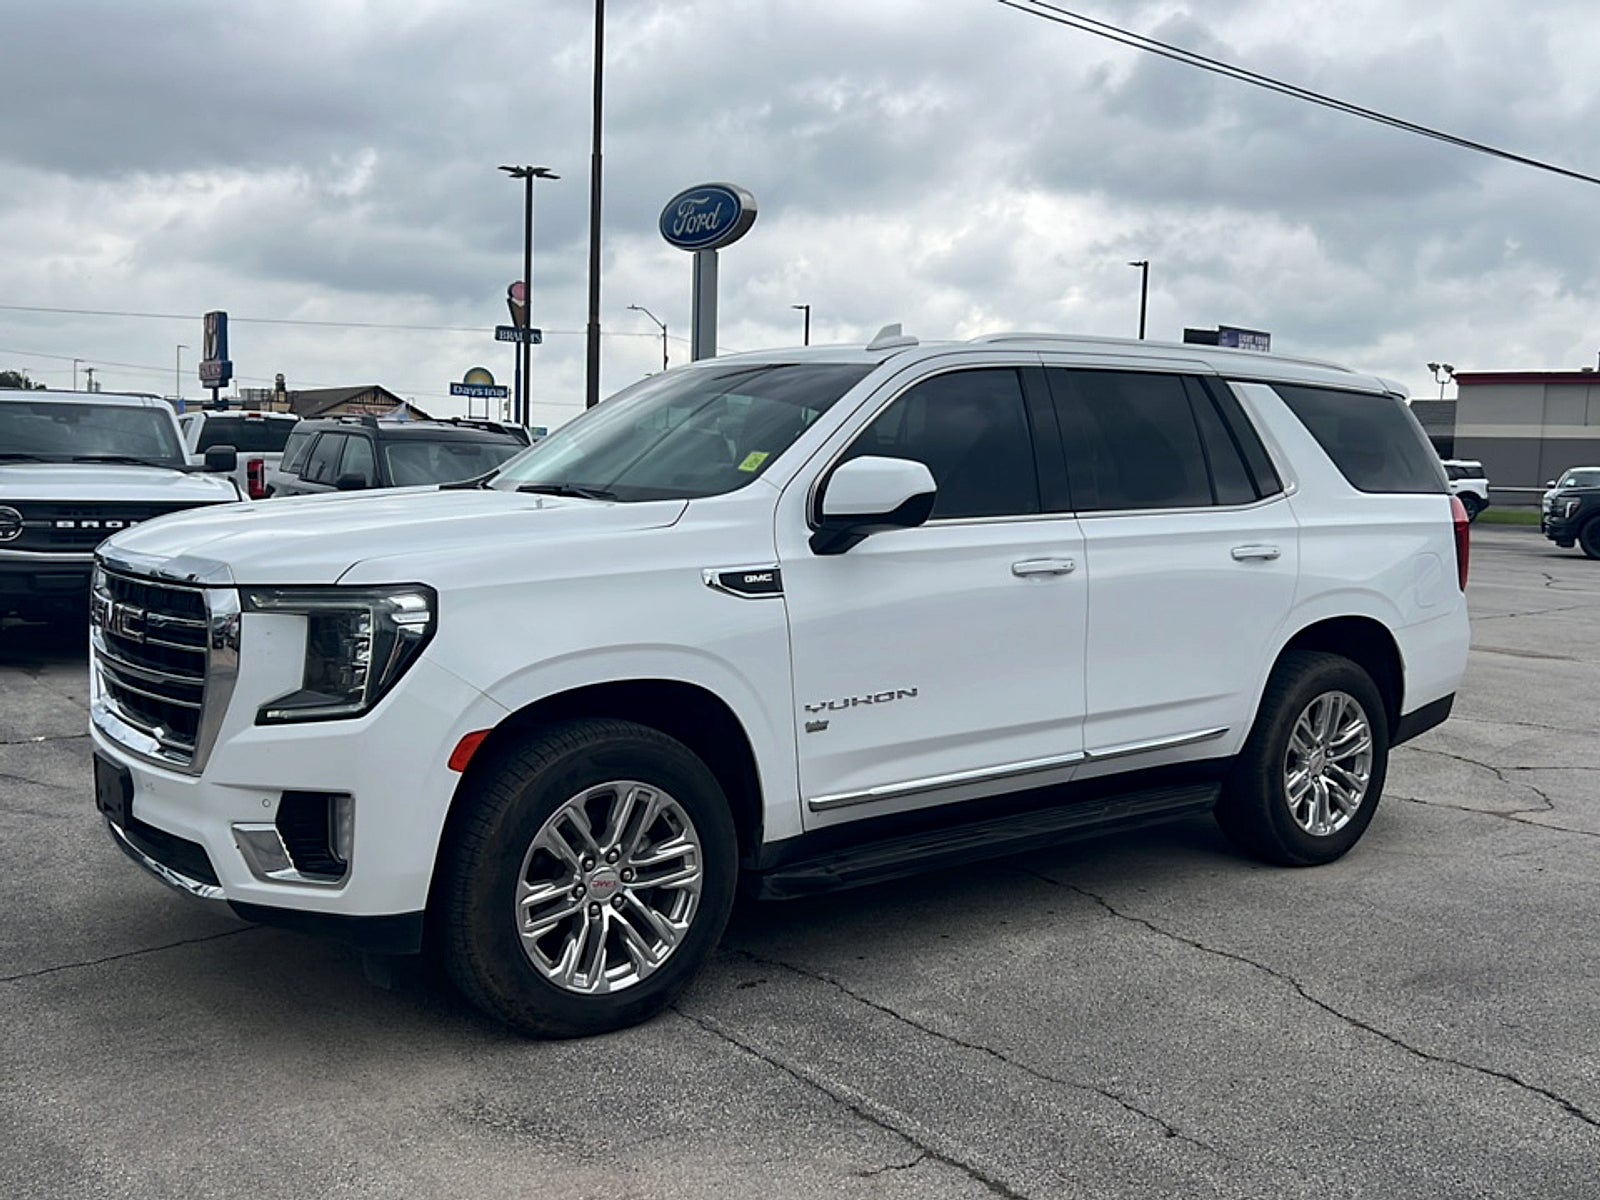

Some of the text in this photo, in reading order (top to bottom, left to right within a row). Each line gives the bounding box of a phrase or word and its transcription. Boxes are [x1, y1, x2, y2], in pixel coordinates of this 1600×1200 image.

[673, 197, 722, 236] Ford
[452, 385, 483, 396] Days
[743, 573, 773, 584] GMC
[804, 688, 918, 712] YUKON
